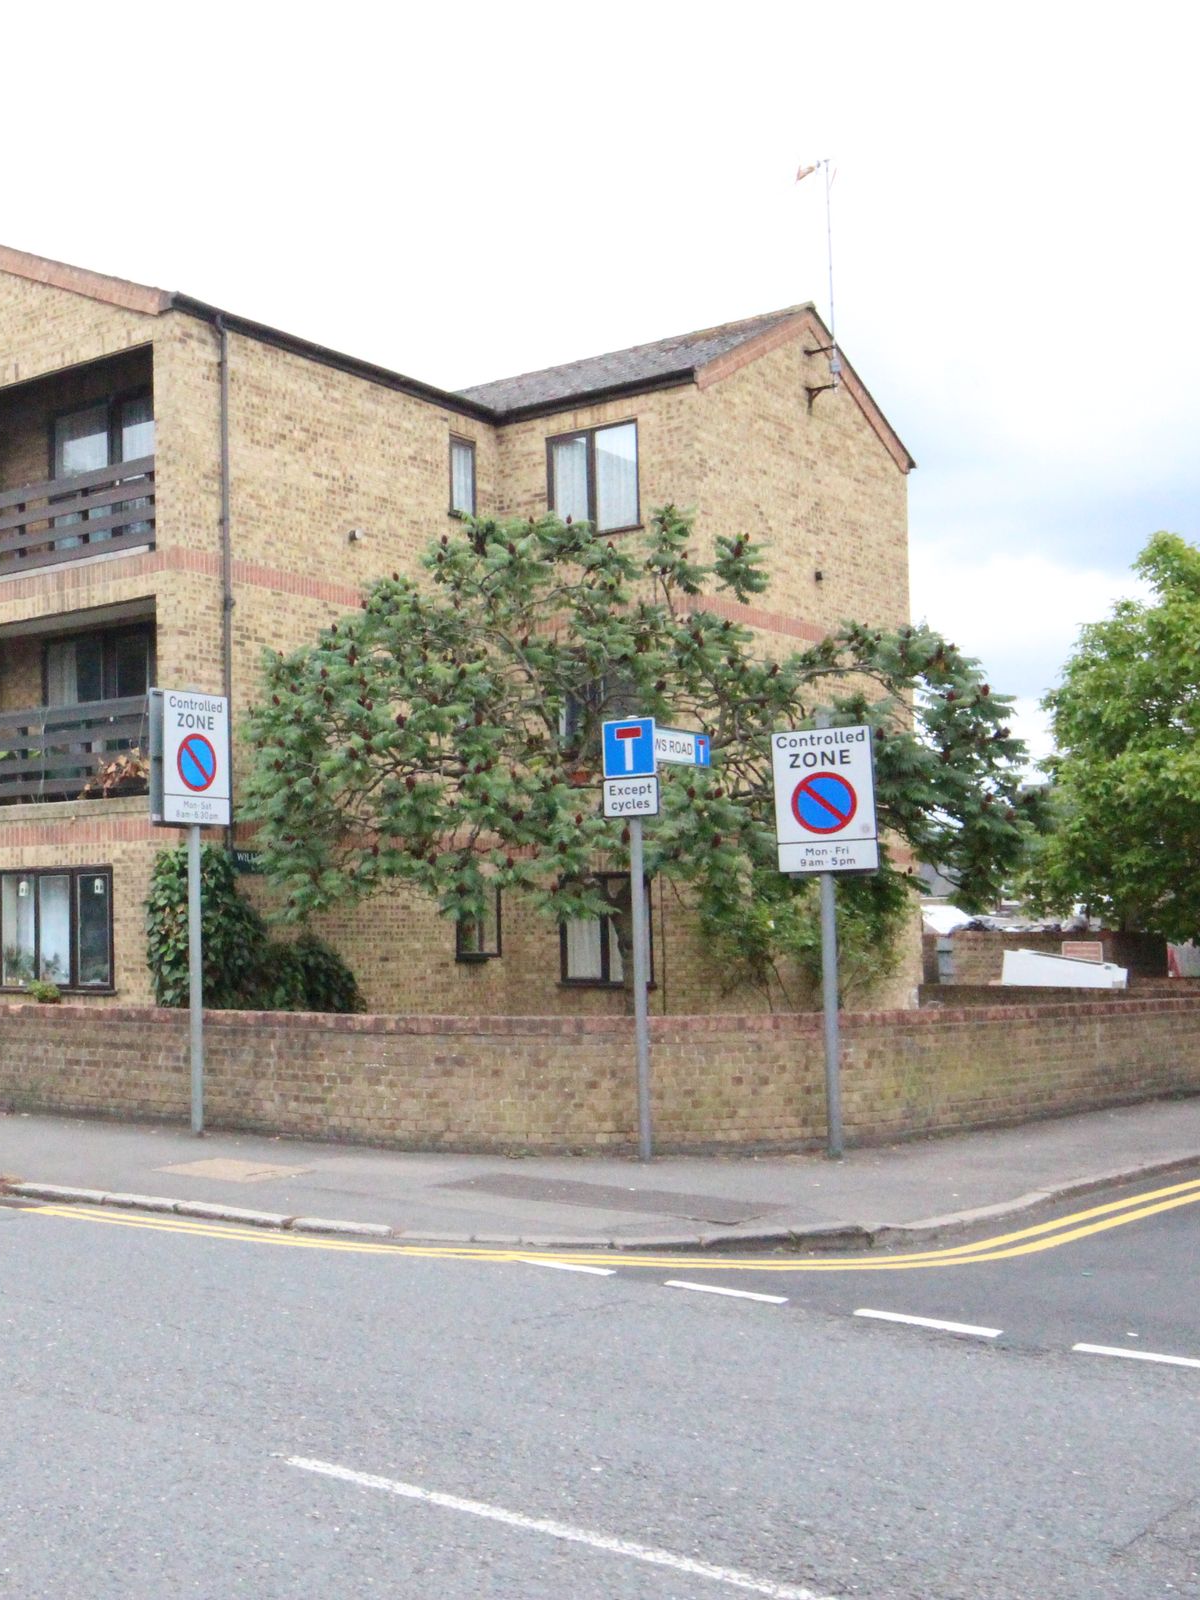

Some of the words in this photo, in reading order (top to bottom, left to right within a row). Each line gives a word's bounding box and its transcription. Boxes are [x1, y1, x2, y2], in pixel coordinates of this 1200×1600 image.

[169, 696, 223, 714] Controlled
[177, 713, 215, 731] ZONE
[669, 740, 693, 756] ROAD
[776, 730, 866, 749] Controlled
[789, 749, 852, 769] ZONE
[609, 783, 652, 796] Except
[611, 799, 650, 812] cycles
[805, 847, 828, 856] Mon
[835, 846, 849, 855] Fri
